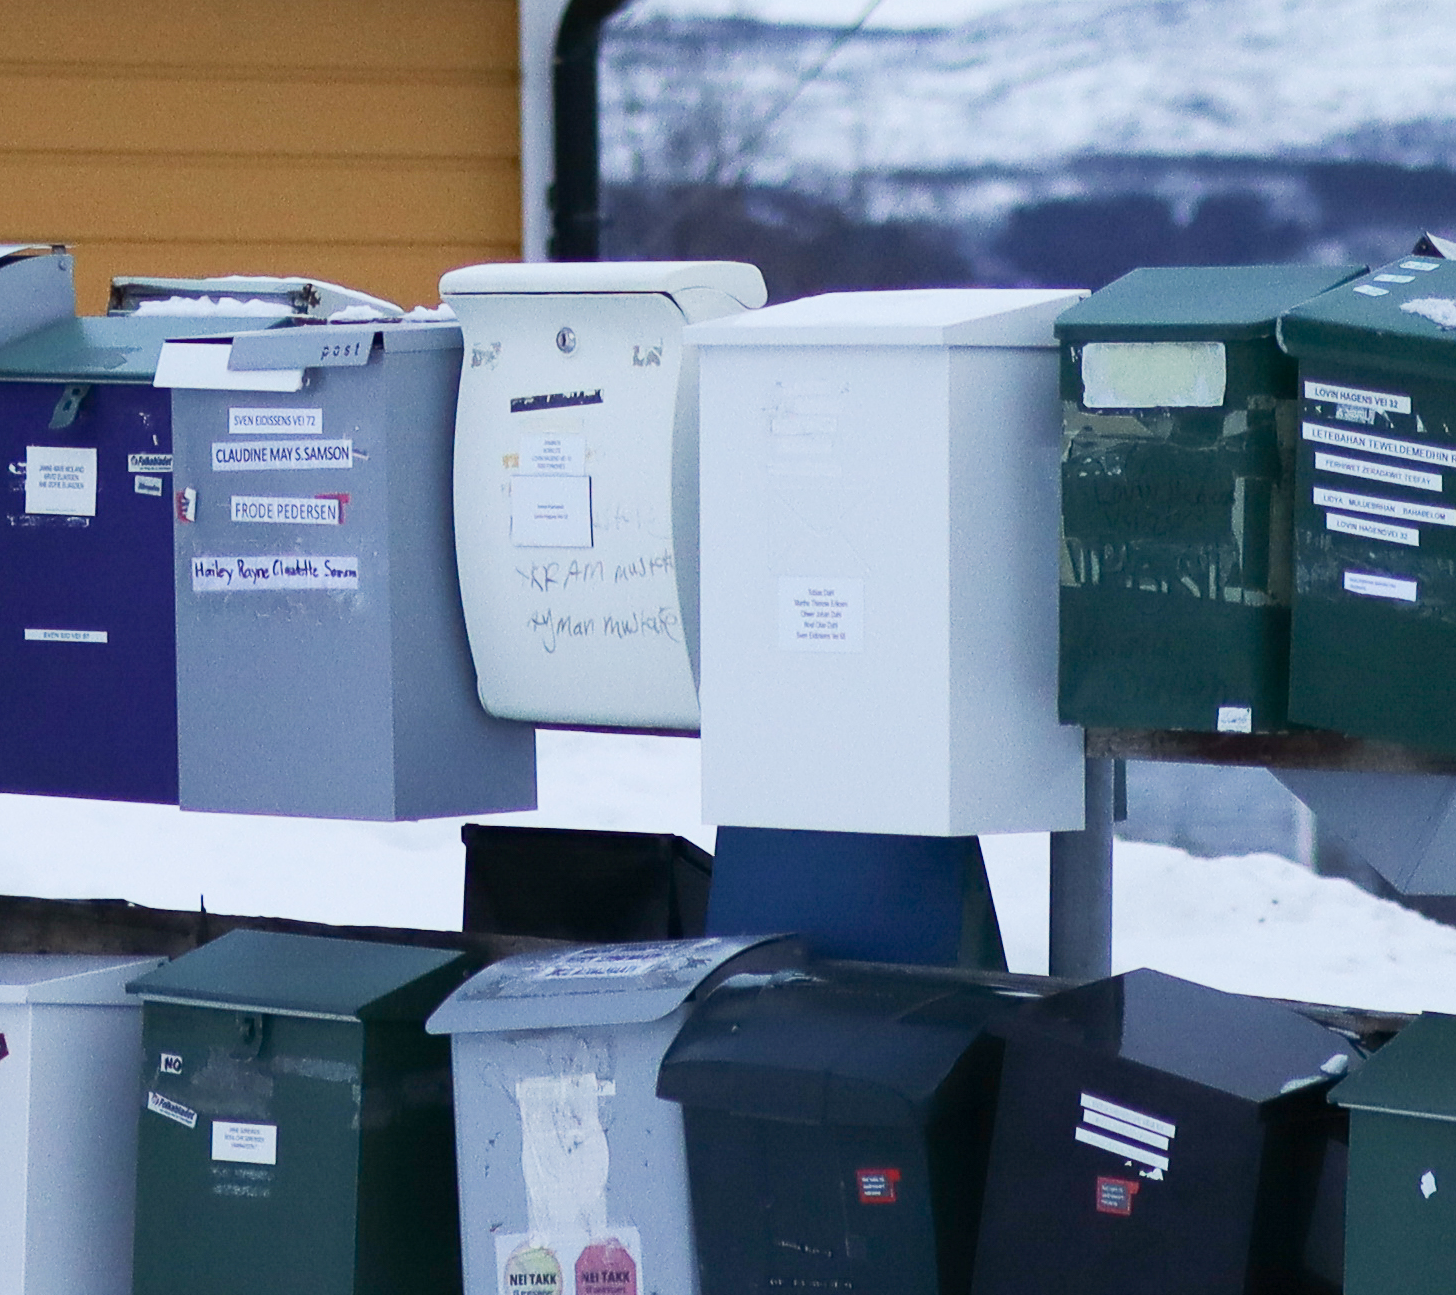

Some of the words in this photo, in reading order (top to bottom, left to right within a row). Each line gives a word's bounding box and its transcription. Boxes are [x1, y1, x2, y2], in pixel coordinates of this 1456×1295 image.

[320, 342, 360, 361] post
[1314, 387, 1338, 399] LOVIN
[1339, 391, 1373, 405] HAGENS
[1374, 397, 1387, 407] VEI
[234, 415, 254, 426] SVEN
[293, 415, 304, 426] VEI
[306, 415, 316, 426] 72
[215, 448, 267, 464] CLAUDINE
[269, 448, 293, 462] MAY
[235, 502, 273, 519] FRODE
[276, 504, 336, 521] PEDERSEN
[194, 559, 233, 585] Hailey
[237, 559, 269, 584] Rayne
[164, 1057, 182, 1072] NO
[510, 1274, 527, 1286] NEI
[529, 1273, 557, 1285] TAKK
[582, 1272, 599, 1283] NEI
[601, 1271, 630, 1283] TAKK
